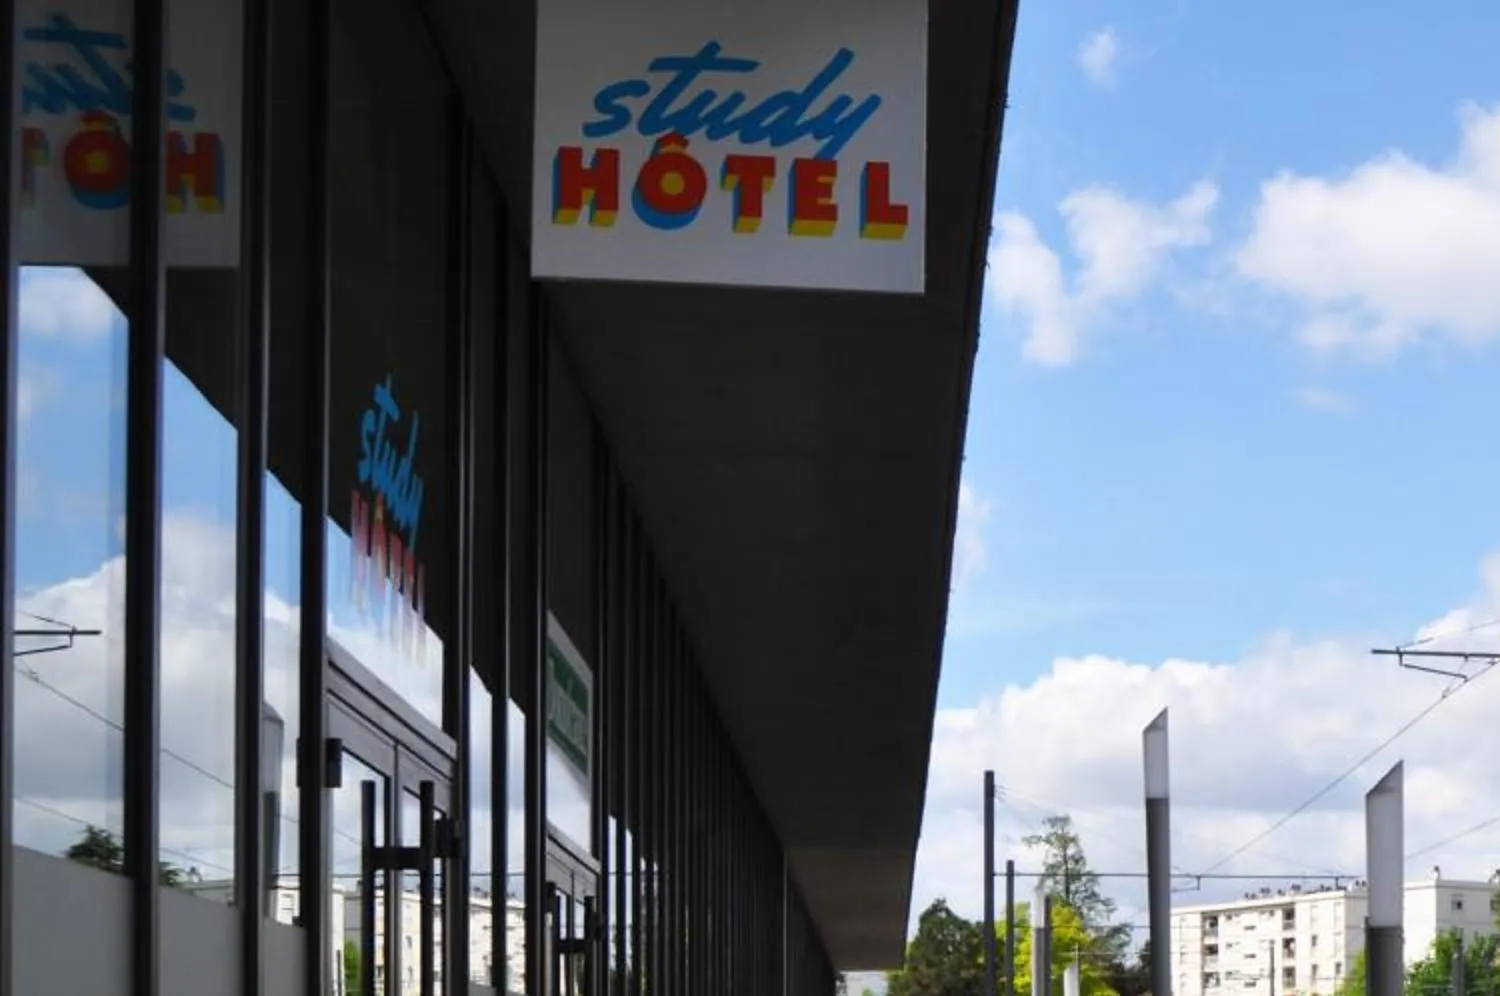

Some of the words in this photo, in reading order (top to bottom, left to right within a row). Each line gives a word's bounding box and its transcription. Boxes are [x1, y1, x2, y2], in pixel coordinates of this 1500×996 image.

[582, 41, 882, 161] study
[552, 131, 909, 240] HÔTEL
[358, 372, 424, 551] study
